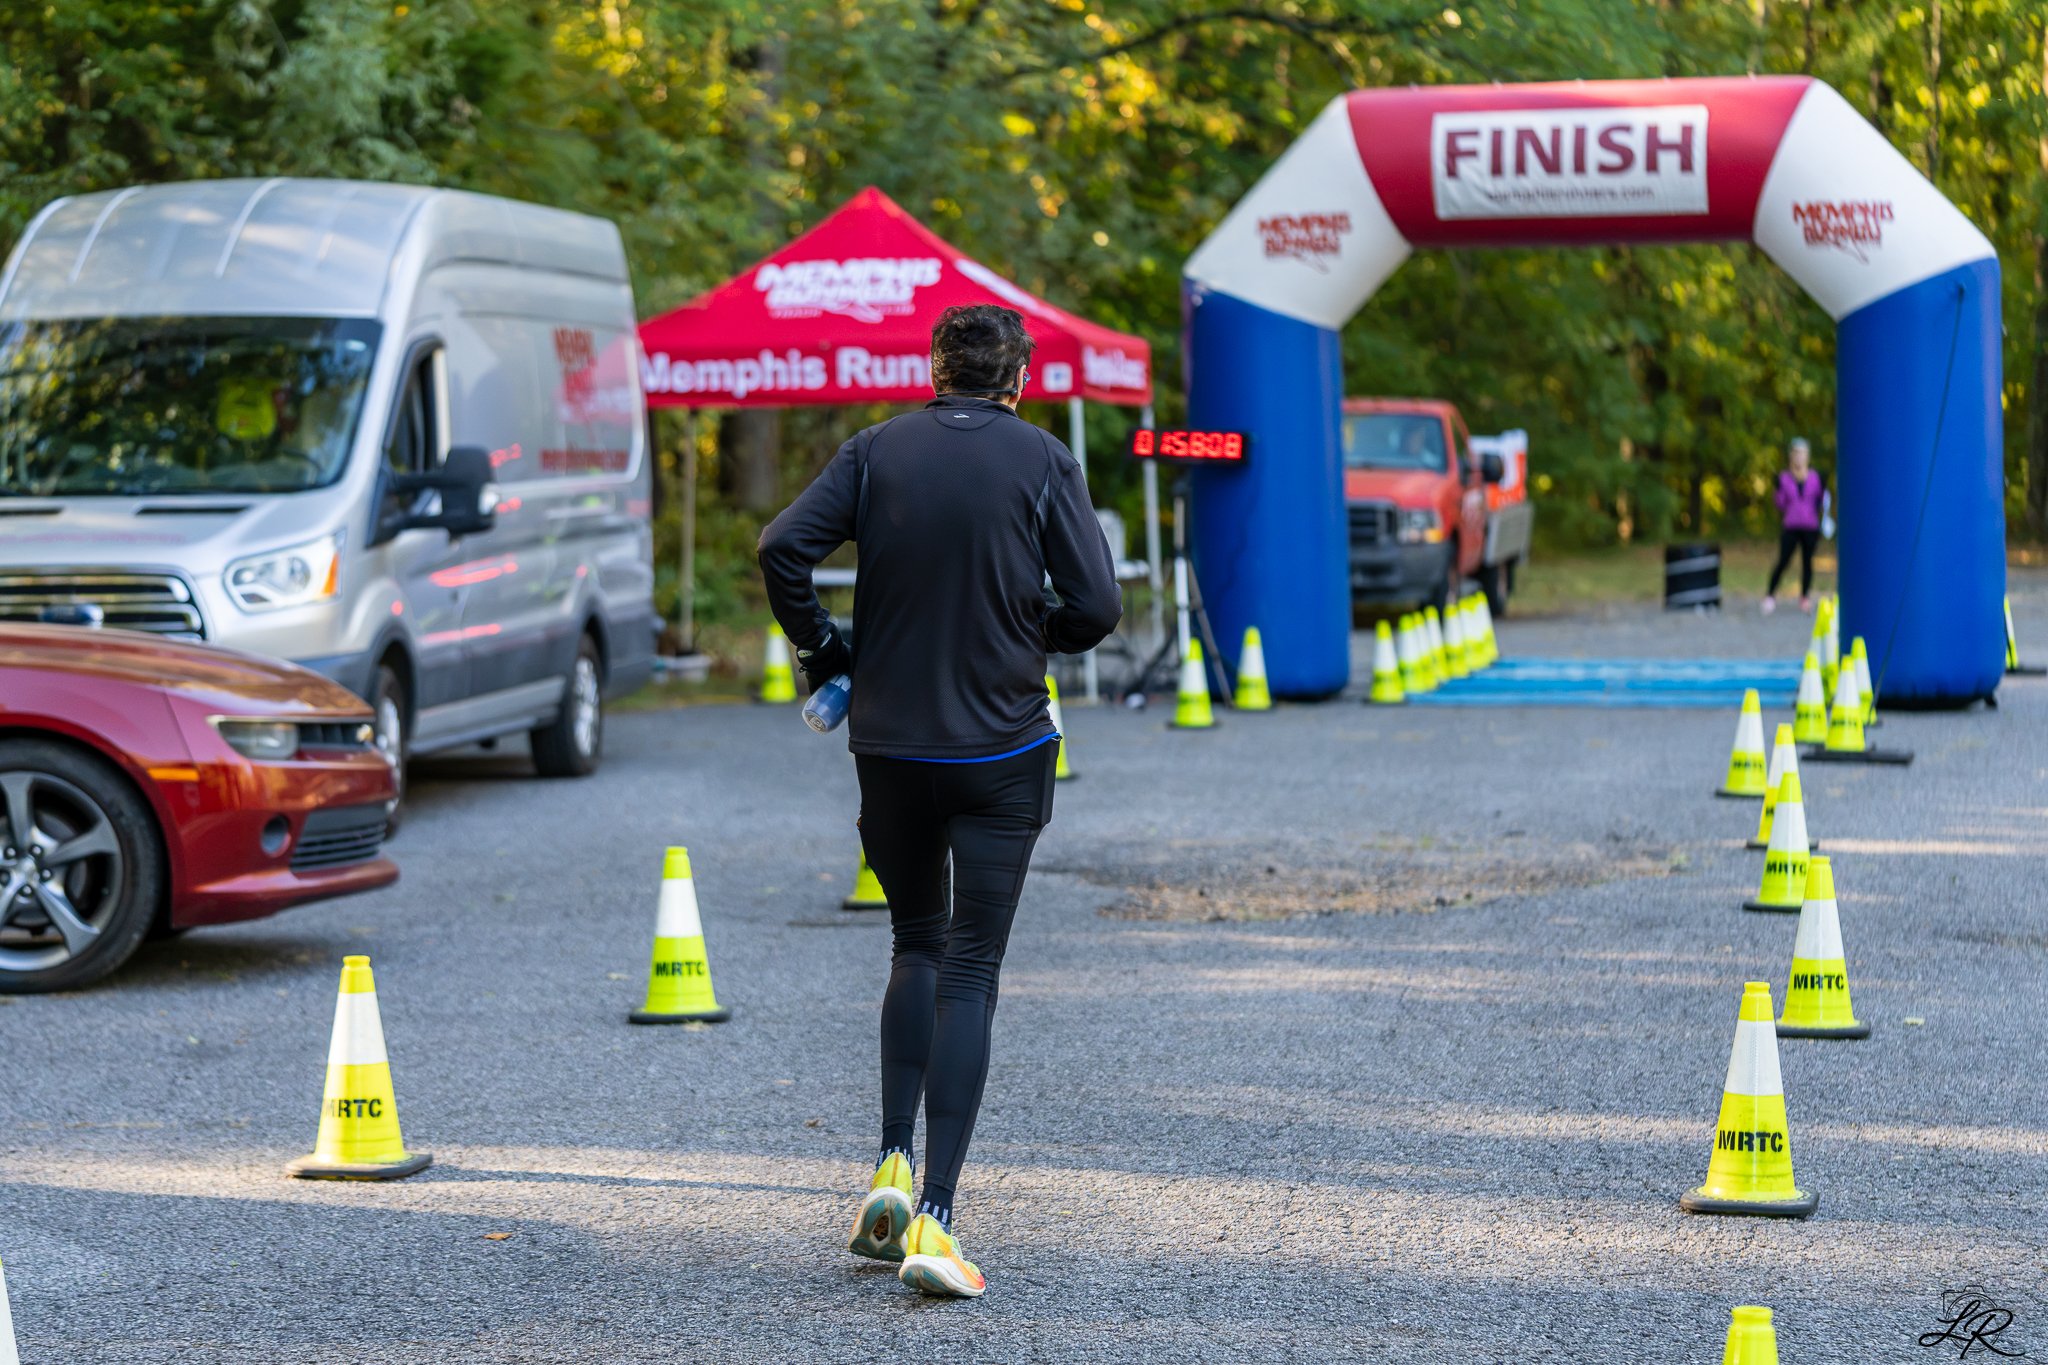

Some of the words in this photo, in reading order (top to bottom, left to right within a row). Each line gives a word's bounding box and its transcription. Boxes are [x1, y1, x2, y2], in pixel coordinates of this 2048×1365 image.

[1445, 122, 1694, 177] FINISH
[641, 348, 827, 397] Memphis
[835, 346, 931, 389] Run
[655, 961, 705, 976] MRTC
[1793, 972, 1845, 991] MRTC
[1717, 1129, 1784, 1153] MRTC
